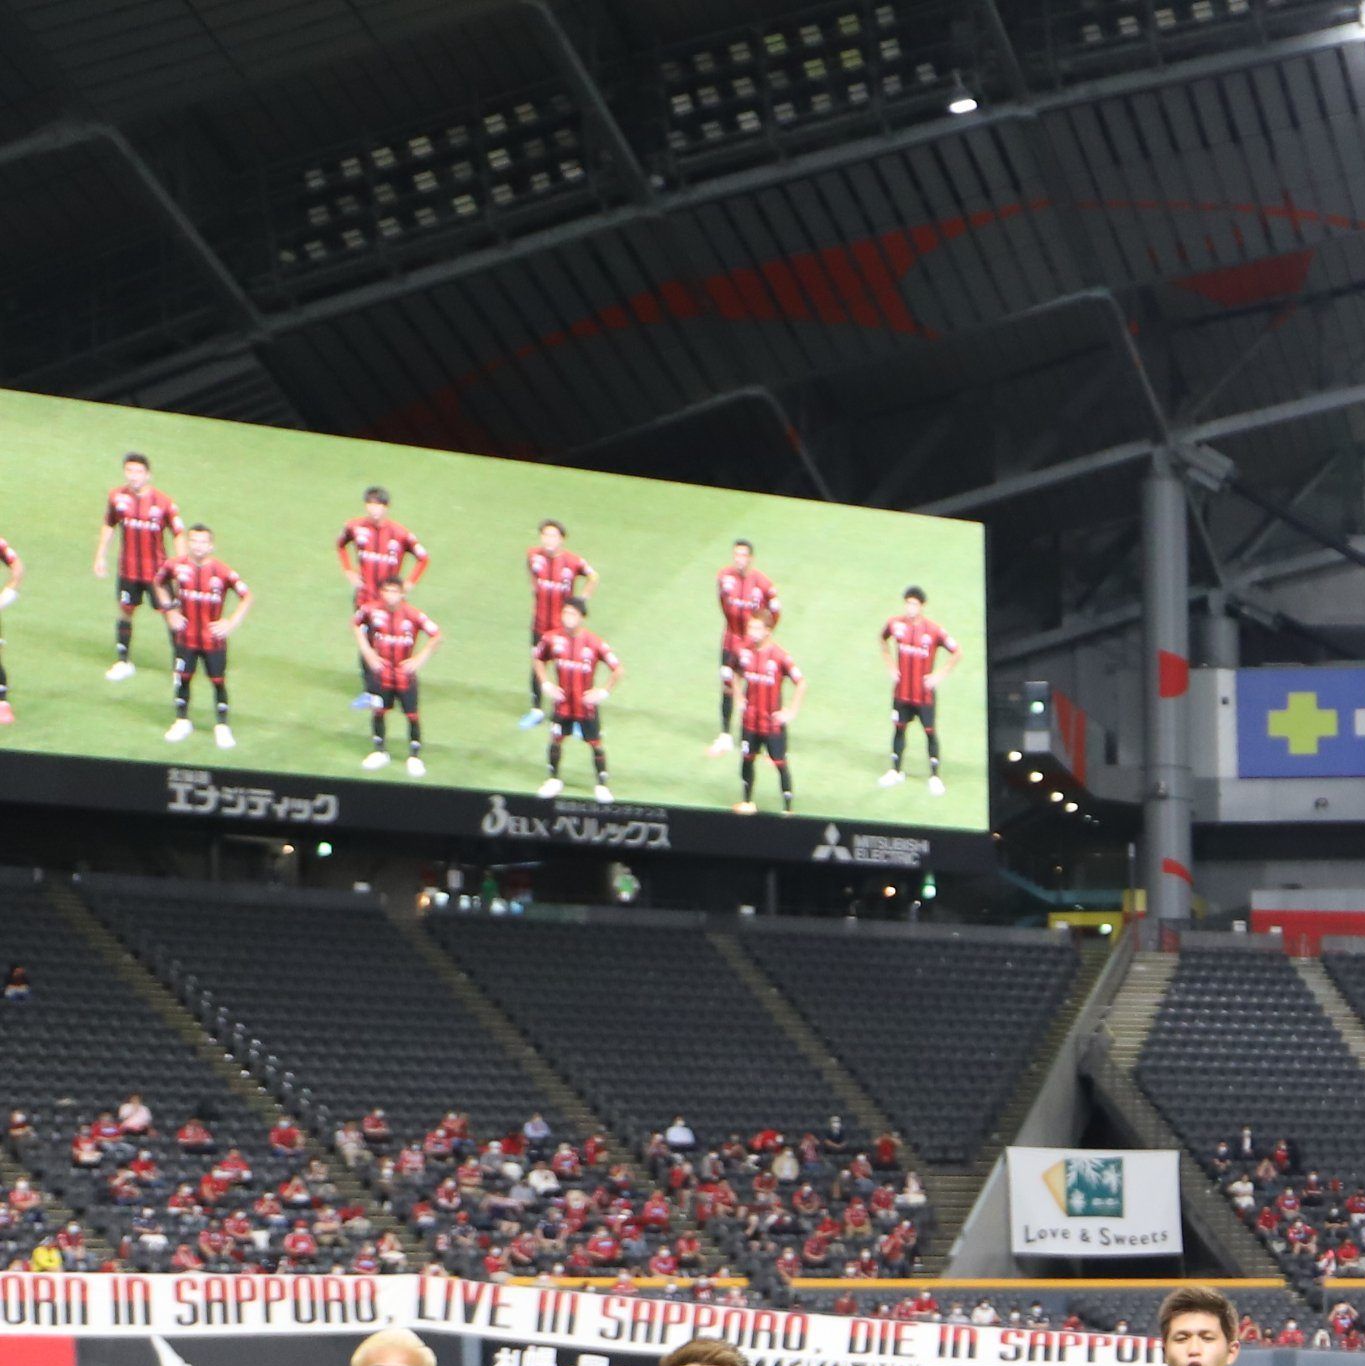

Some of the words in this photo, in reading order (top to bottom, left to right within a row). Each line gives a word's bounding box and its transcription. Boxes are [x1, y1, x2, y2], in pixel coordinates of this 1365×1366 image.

[853, 835, 931, 855] MITSUBISHI
[852, 849, 920, 867] ELECTRIC
[1024, 1224, 1071, 1244] Love
[1080, 1228, 1091, 1243] &
[1099, 1227, 1168, 1246] Sweets
[112, 1276, 151, 1326] IN
[418, 1274, 513, 1329] LIVE
[849, 1318, 919, 1358] DIE
[939, 1323, 979, 1361] IN
